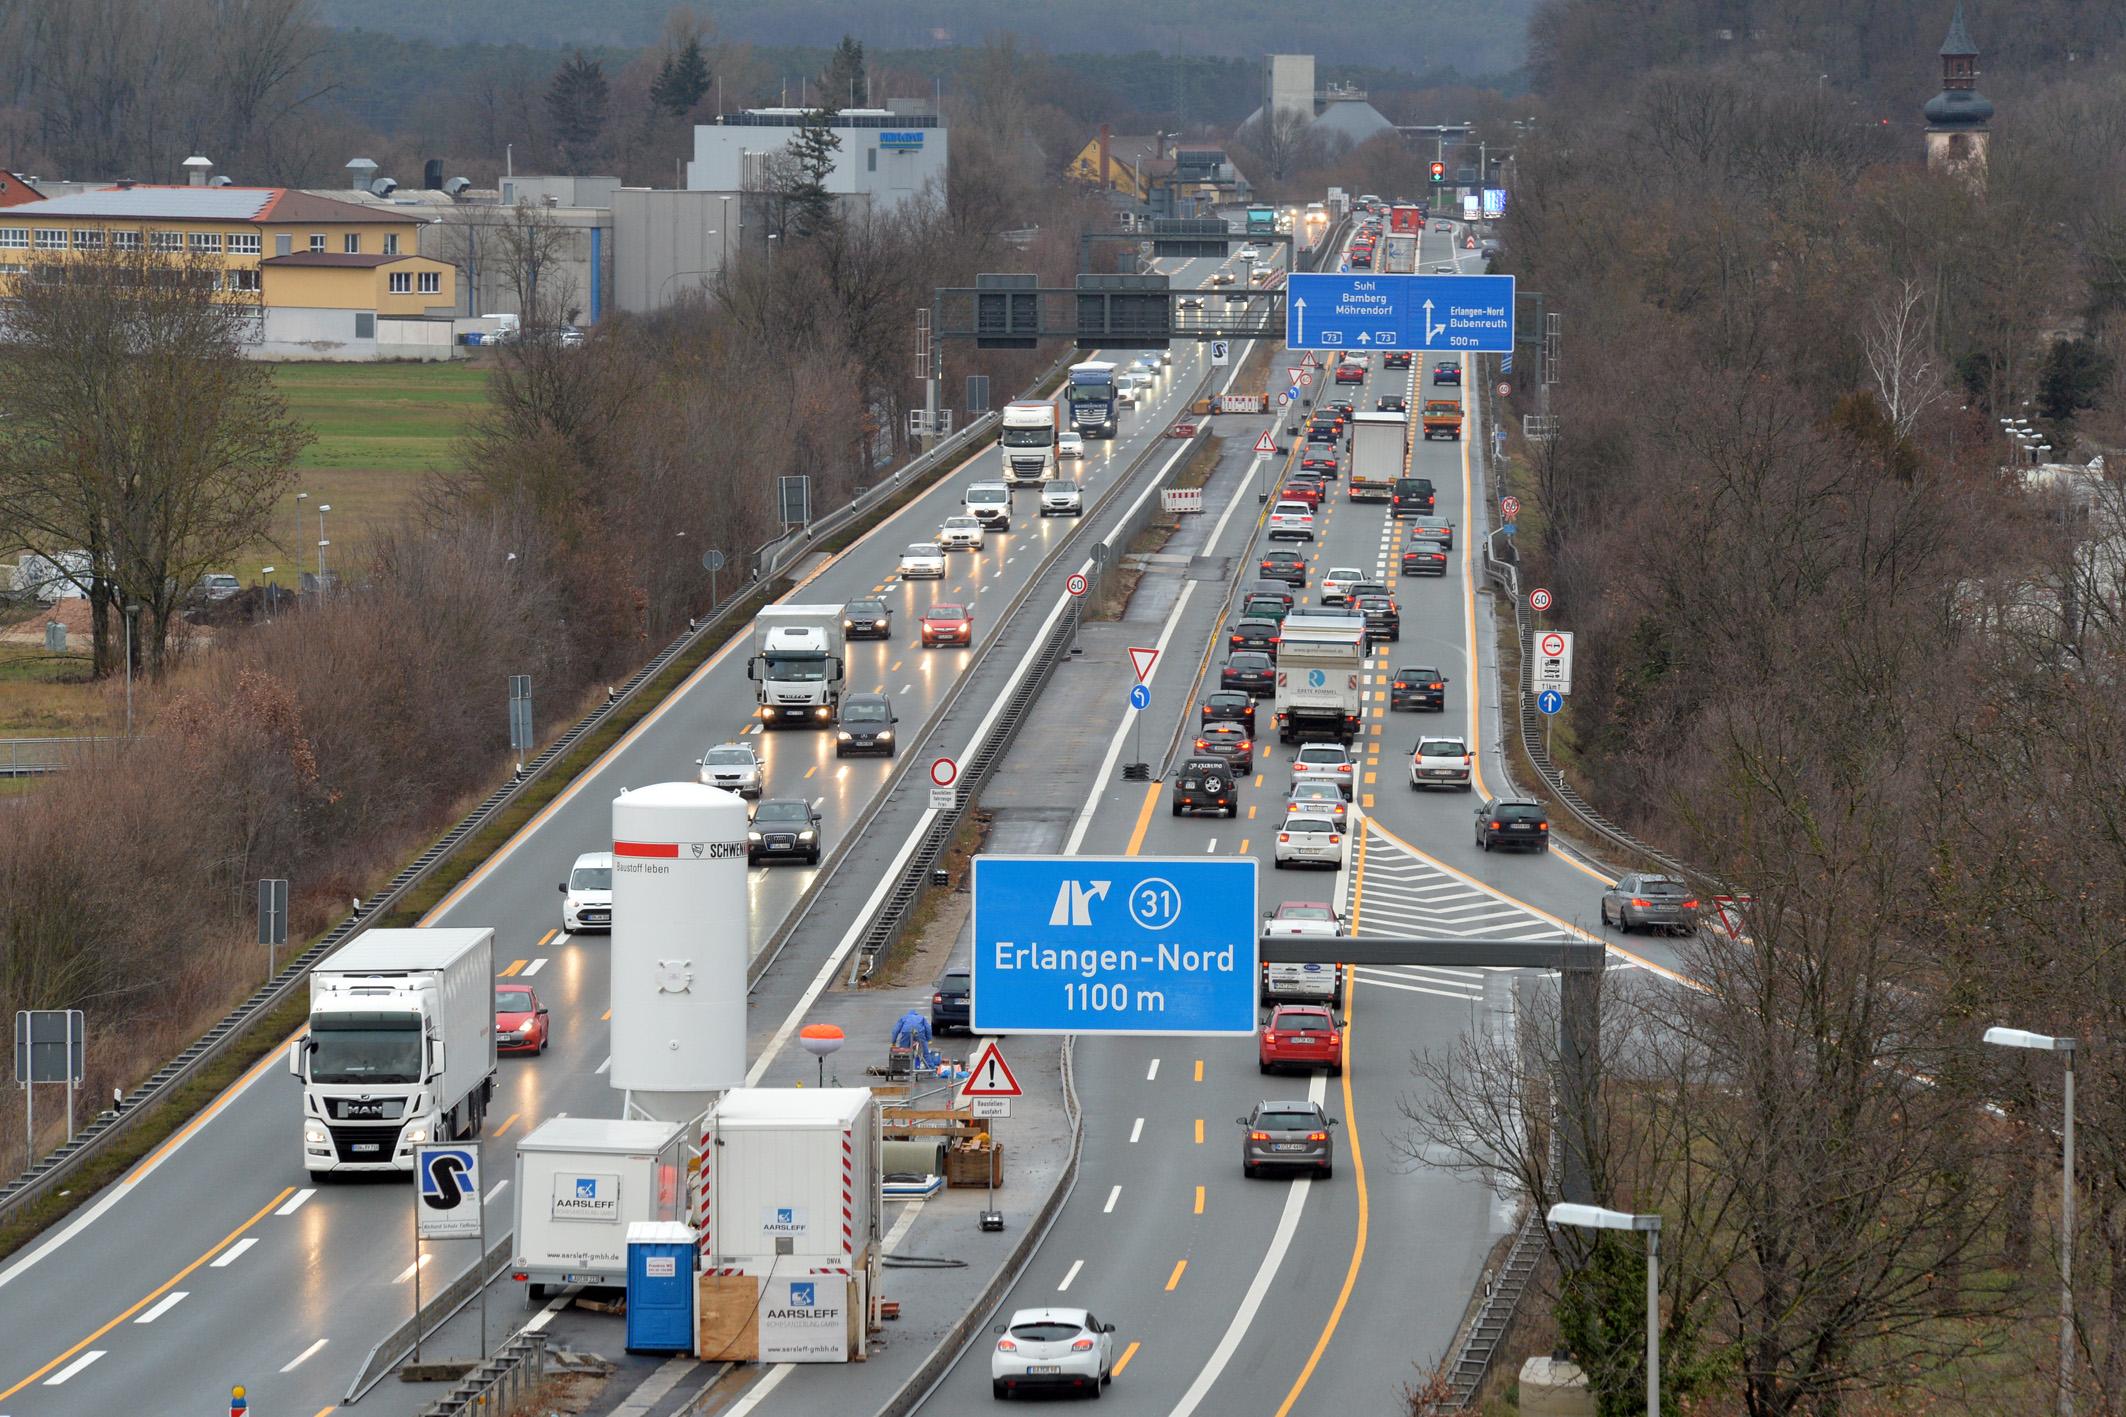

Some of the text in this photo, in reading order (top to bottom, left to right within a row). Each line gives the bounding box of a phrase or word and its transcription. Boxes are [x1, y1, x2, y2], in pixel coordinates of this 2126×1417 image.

[1354, 281, 1376, 291] Suhl
[1342, 293, 1387, 304] Bamberg
[1336, 305, 1393, 315] Möhrendorf
[1450, 307, 1504, 318] Erlangen-Nord
[1450, 318, 1507, 328] Bubenreuth
[1327, 334, 1337, 342] 73
[1381, 334, 1391, 342] 73
[1450, 337, 1468, 346] 500
[1071, 579, 1083, 590] 60
[1535, 595, 1547, 605] 60
[617, 862, 670, 874] Baustoff leben
[1140, 890, 1170, 918] 31
[995, 942, 1234, 978] Erlangen-Nord
[1064, 983, 1165, 1012] 1100 m
[348, 1106, 383, 1114] MAN
[557, 1200, 615, 1208] AARSLEFF
[547, 1251, 619, 1261] www.aarsleff-gmbh.de
[768, 1309, 839, 1319] AARSLEFF
[768, 1345, 839, 1354] www.aarsleff-gmbh.de
